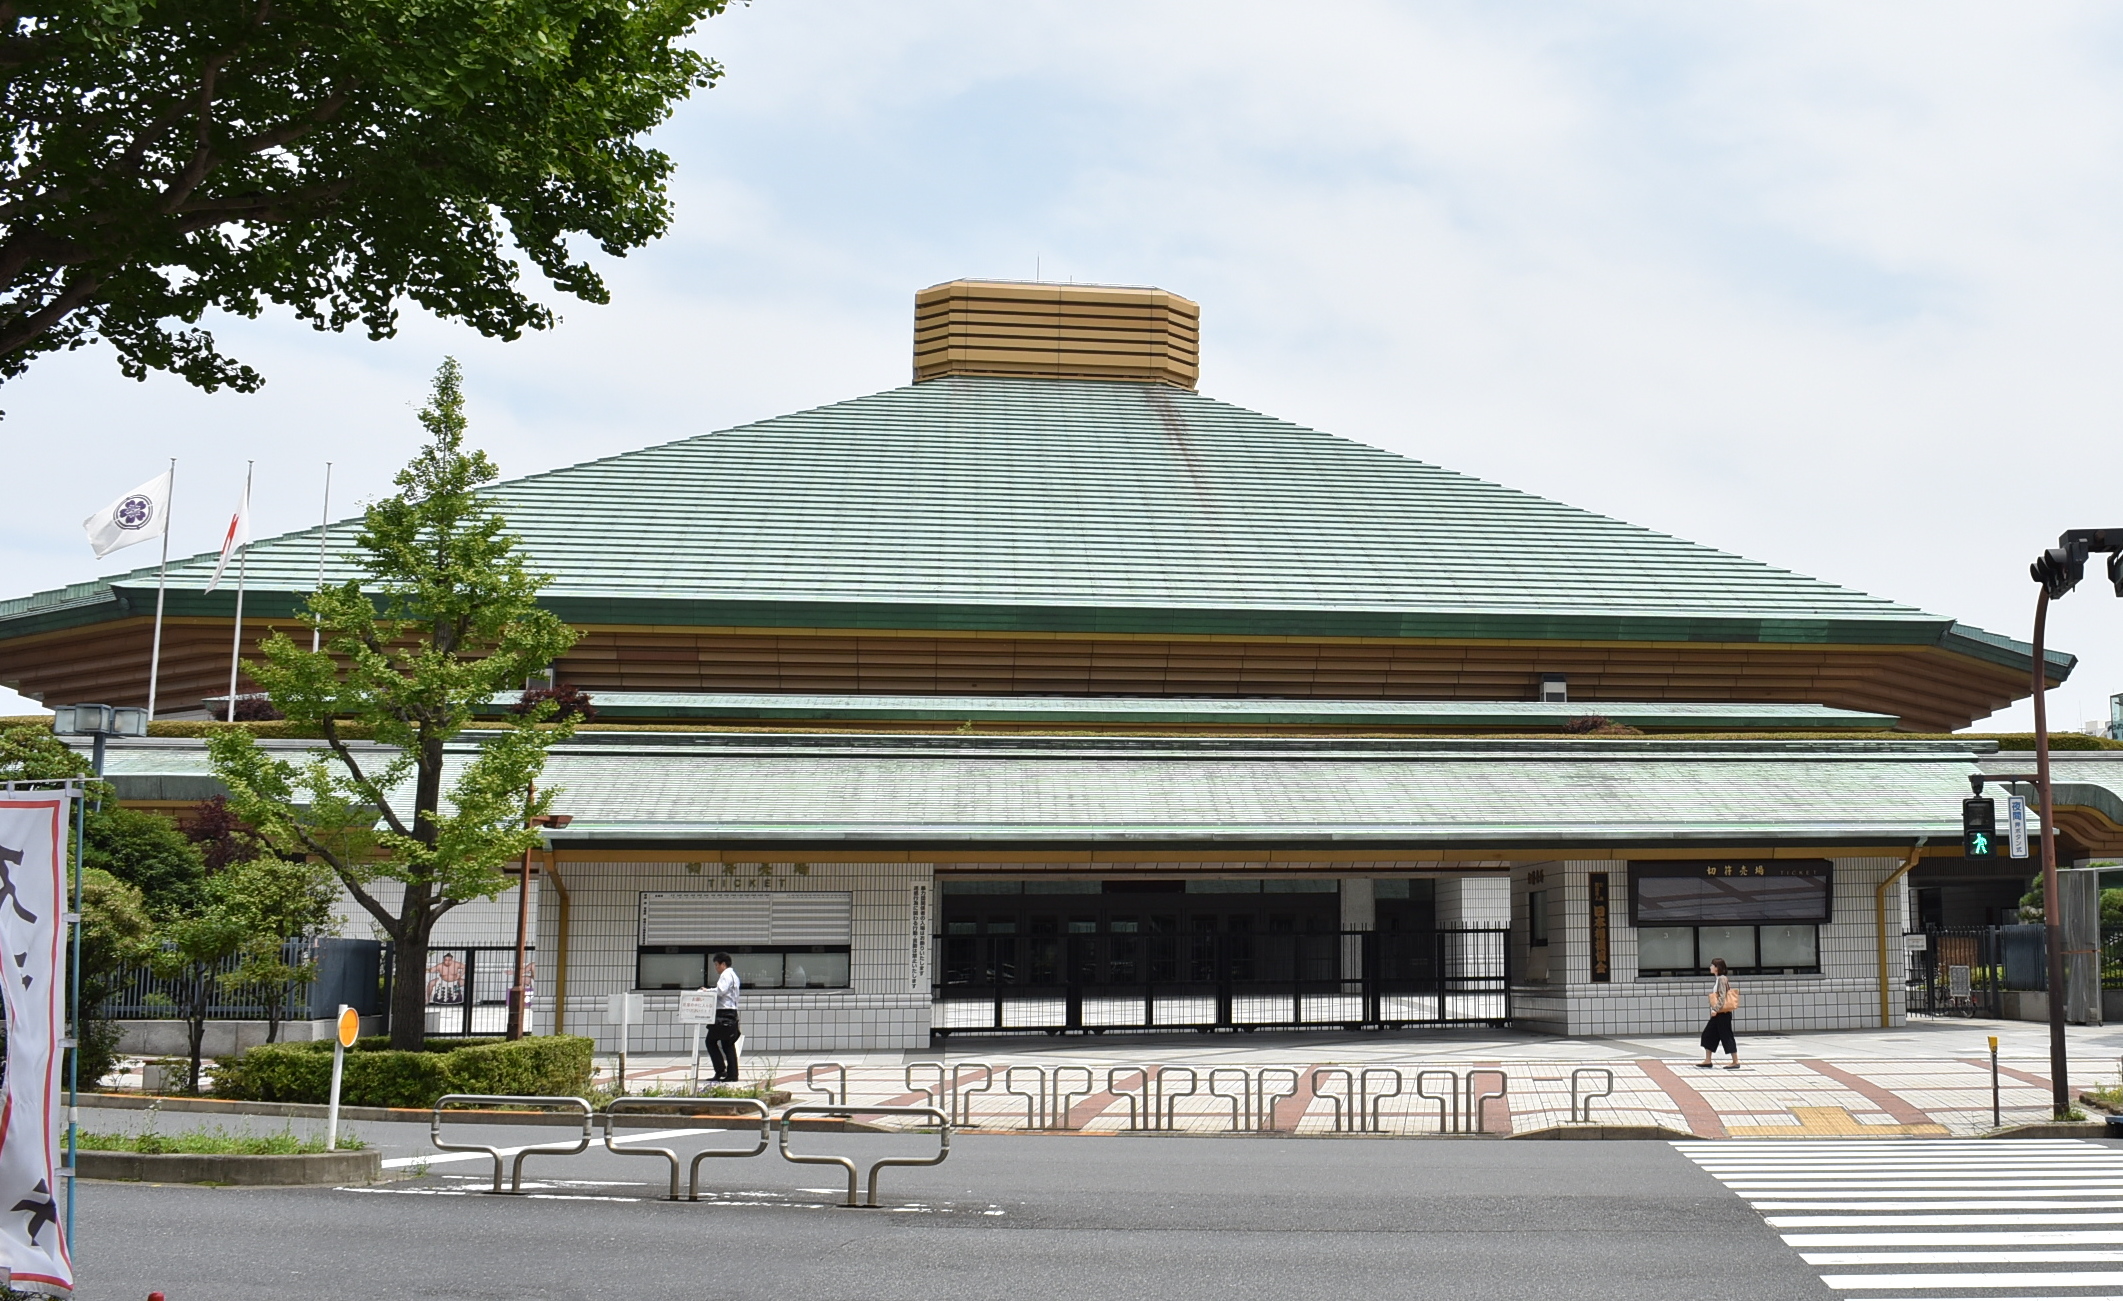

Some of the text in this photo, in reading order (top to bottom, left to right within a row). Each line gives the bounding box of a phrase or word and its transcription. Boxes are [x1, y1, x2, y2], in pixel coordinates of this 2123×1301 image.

[1706, 865, 1764, 876] 切符売場
[708, 879, 785, 887] TICKET
